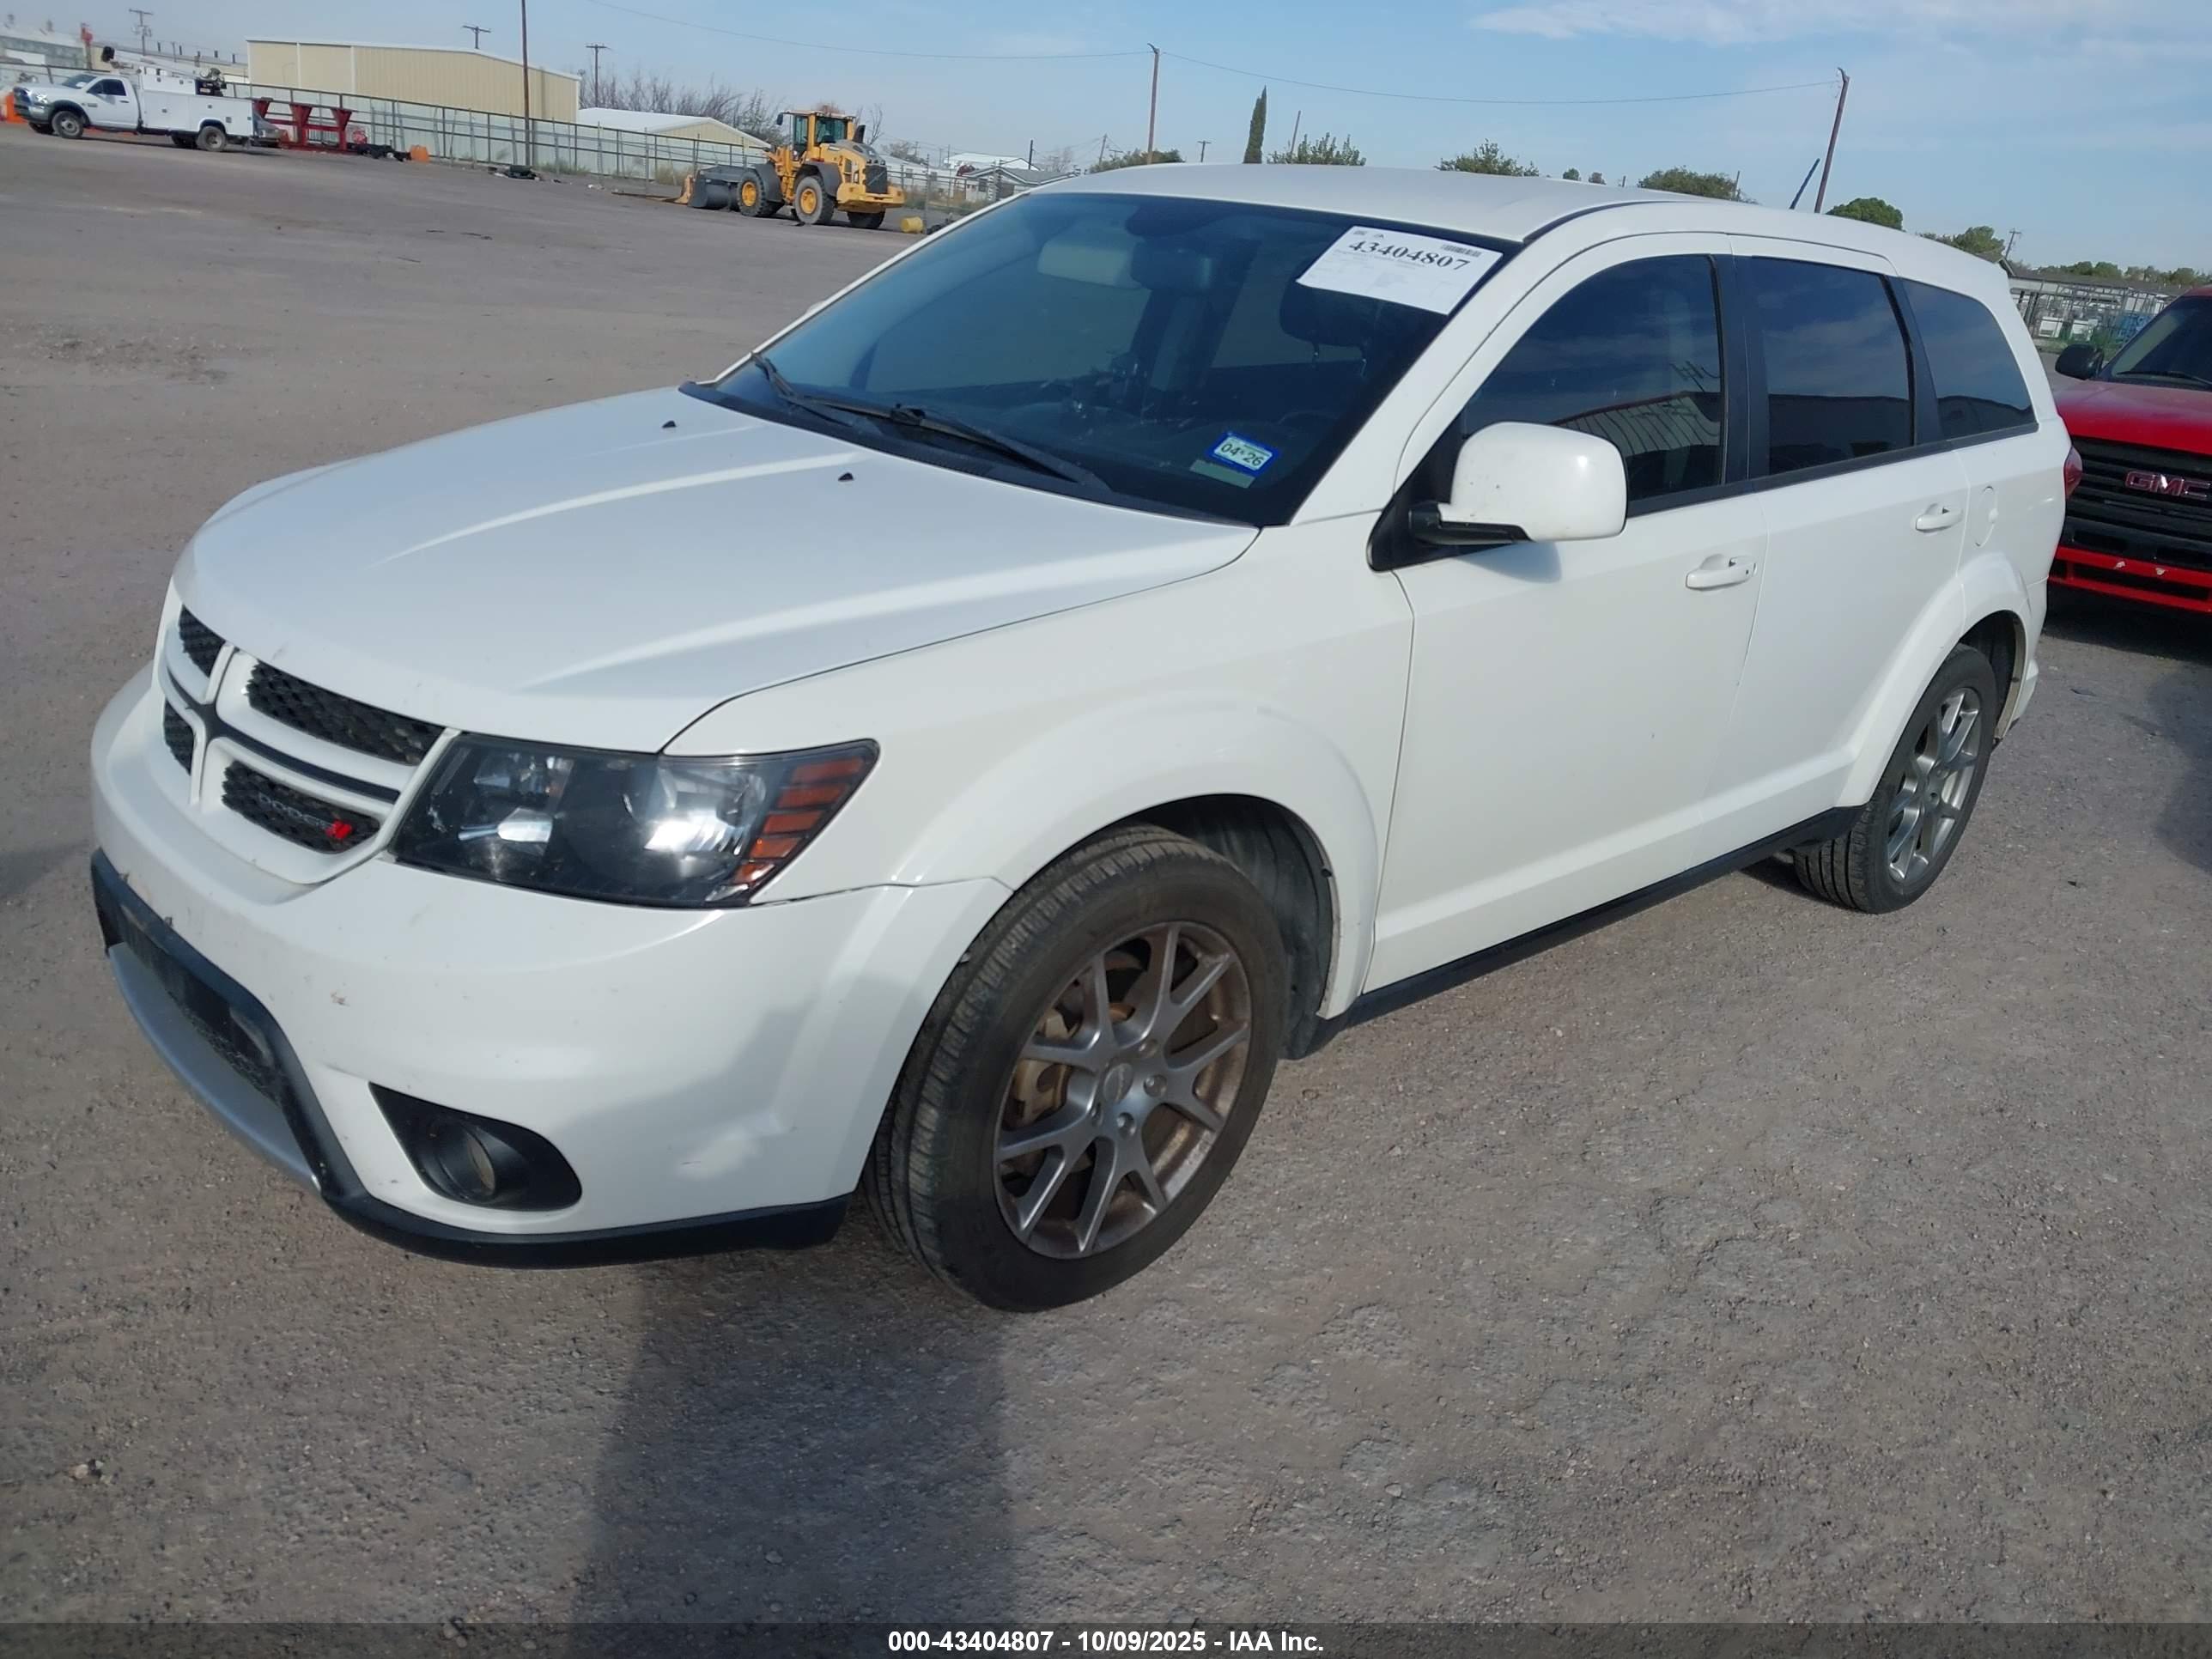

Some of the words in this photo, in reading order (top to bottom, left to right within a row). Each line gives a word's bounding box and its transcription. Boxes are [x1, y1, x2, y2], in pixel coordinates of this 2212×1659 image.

[1349, 240, 1472, 270] 43404807
[1220, 443, 1241, 456] 04
[1243, 452, 1265, 467] 26
[2125, 471, 2212, 500] GMC
